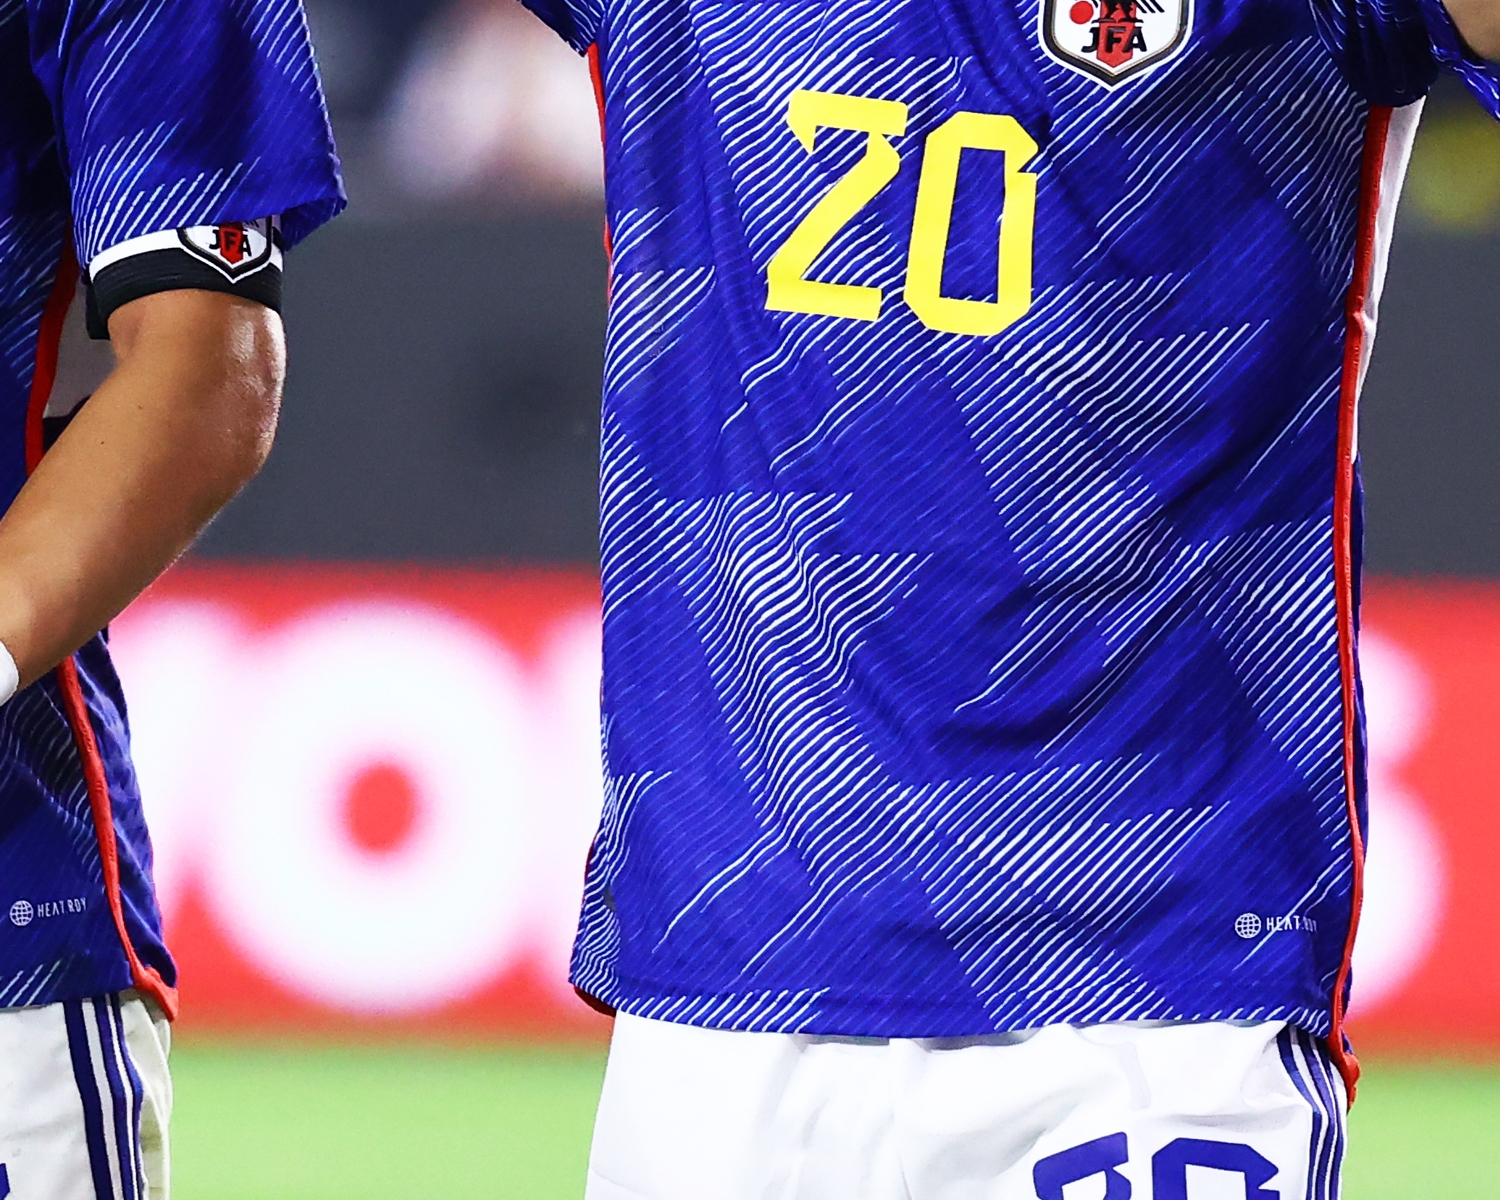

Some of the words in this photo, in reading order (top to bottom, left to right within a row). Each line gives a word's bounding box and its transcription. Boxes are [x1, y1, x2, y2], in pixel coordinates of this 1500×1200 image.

[1081, 26, 1147, 53] JFA
[764, 88, 1039, 337] 20
[208, 228, 252, 257] JFA
